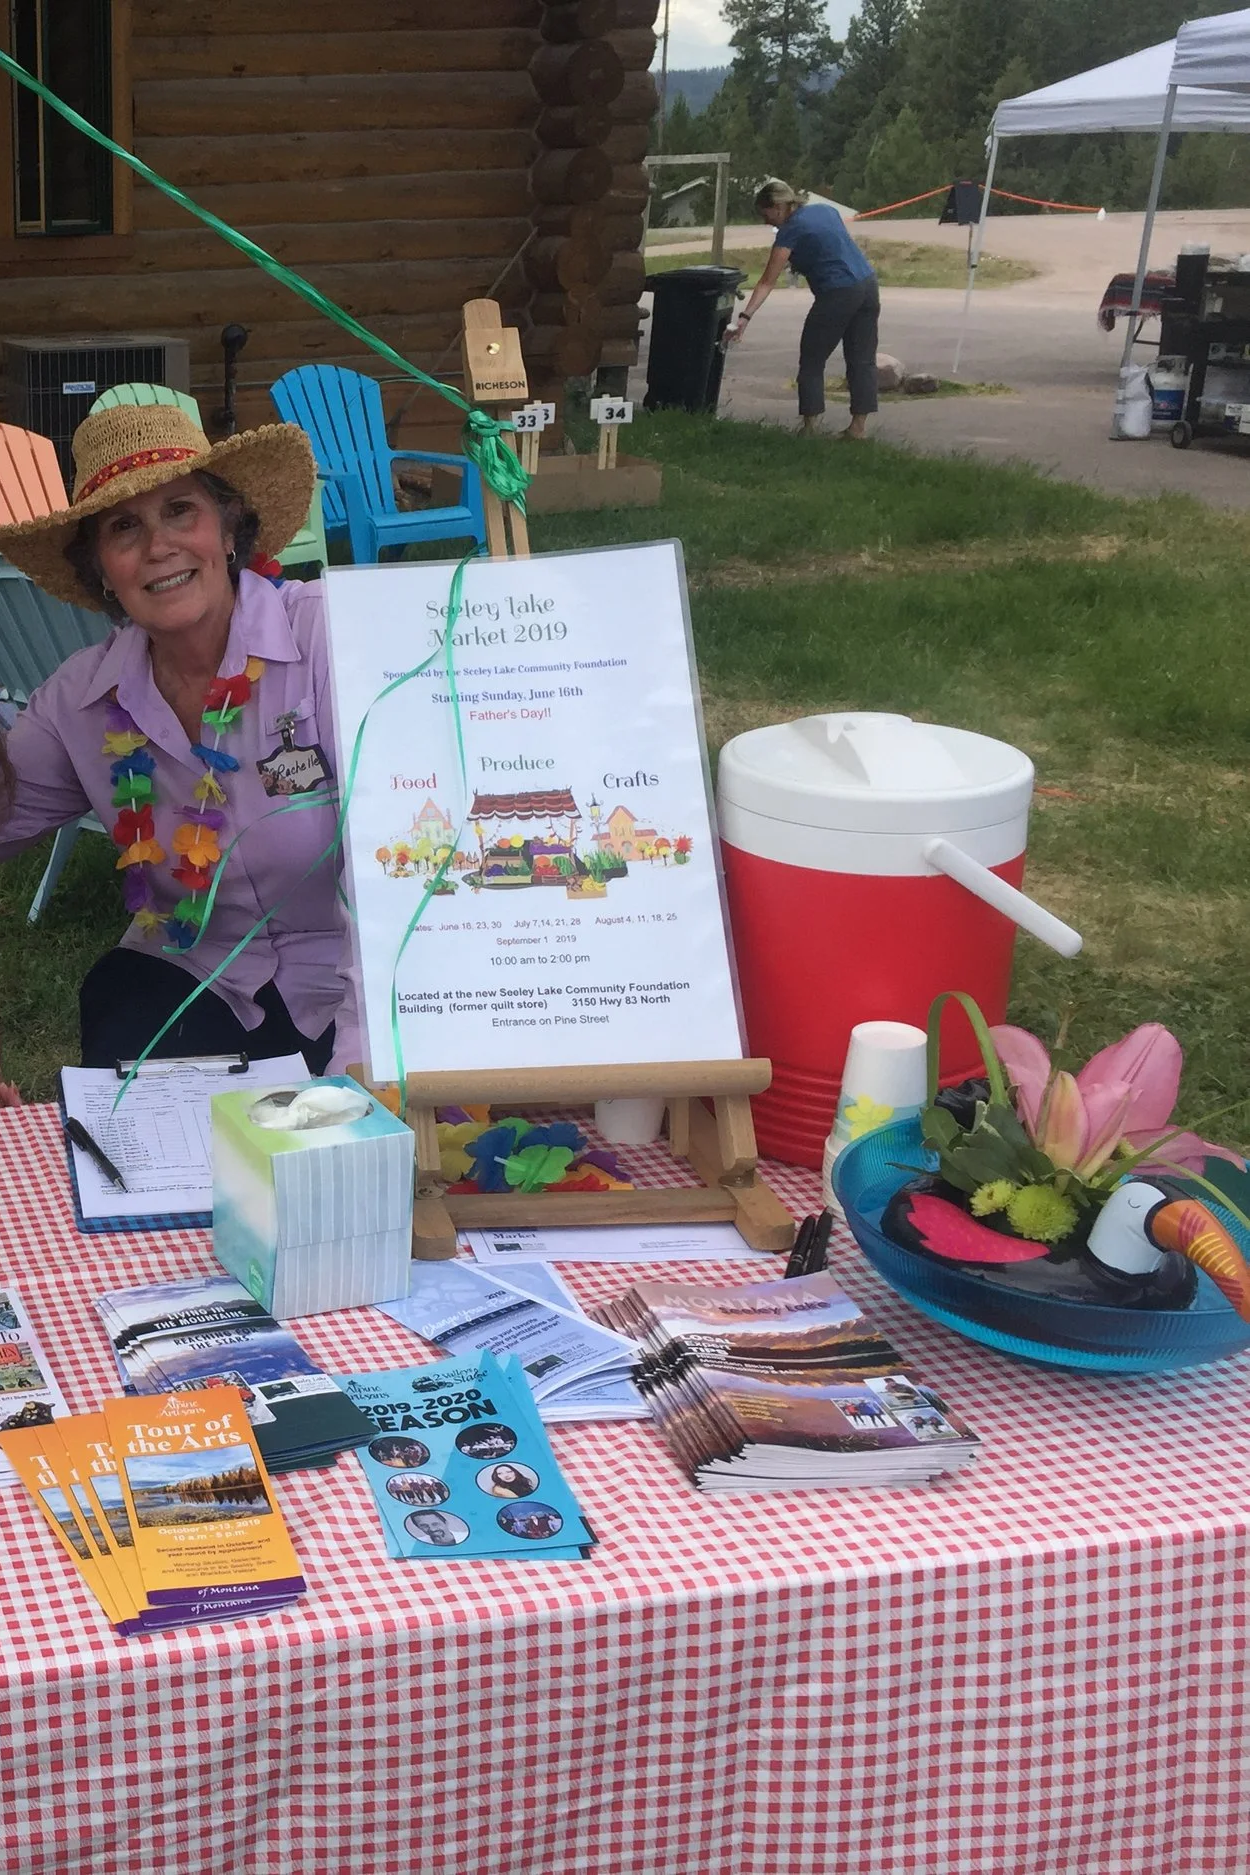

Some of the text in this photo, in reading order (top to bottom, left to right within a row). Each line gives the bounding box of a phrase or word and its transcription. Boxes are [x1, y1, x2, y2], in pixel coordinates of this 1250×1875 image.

[476, 381, 525, 390] RICHESON
[517, 415, 536, 428] 33
[605, 407, 626, 419] 34
[426, 594, 554, 621] Seeley Lake
[427, 621, 567, 647] Market 2019
[433, 669, 444, 679] by
[463, 667, 492, 677] Seeley
[494, 665, 516, 675] Lake
[518, 663, 571, 674] Community
[574, 658, 627, 670] Foundation
[482, 689, 526, 702] Sunday,
[529, 688, 556, 700] June
[559, 687, 583, 697] 16th
[470, 707, 551, 721] Father's Day!!
[277, 755, 320, 778] Rachelle
[478, 754, 556, 772] Produce
[389, 770, 659, 791] Food Crafts
[438, 922, 459, 931] June
[476, 922, 488, 930] 23,
[491, 920, 502, 929] 30
[514, 920, 530, 929] July
[555, 918, 568, 928] 21,
[570, 918, 581, 926] 28
[595, 916, 624, 926] August
[626, 916, 634, 924] 4,
[637, 915, 649, 924] 11,
[652, 914, 664, 923] 18,
[667, 912, 678, 921] 25
[496, 936, 541, 947] September
[556, 934, 577, 943] 2019
[490, 954, 590, 966] 10:00 am to 2:00 pm
[398, 981, 690, 1001] Located at the new Seeley Lake Community Foundation
[399, 993, 671, 1015] Building (former quilt store) 3150 Hwy 83 North
[492, 1013, 610, 1028] Entrance on Pine Street
[167, 1308, 208, 1320] LIVING
[718, 1301, 831, 1315] Seeley Lake
[154, 1311, 249, 1330] THE MOUNTAINS.
[173, 1327, 258, 1346] REACHING FOR
[190, 1336, 255, 1350] THE STARS.
[359, 1388, 482, 1416] 2019-2020
[370, 1399, 498, 1433] EASON
[126, 1414, 233, 1440] Tour of
[126, 1431, 242, 1453] the Arts
[158, 1526, 200, 1535] October
[198, 1584, 260, 1598] of Montana
